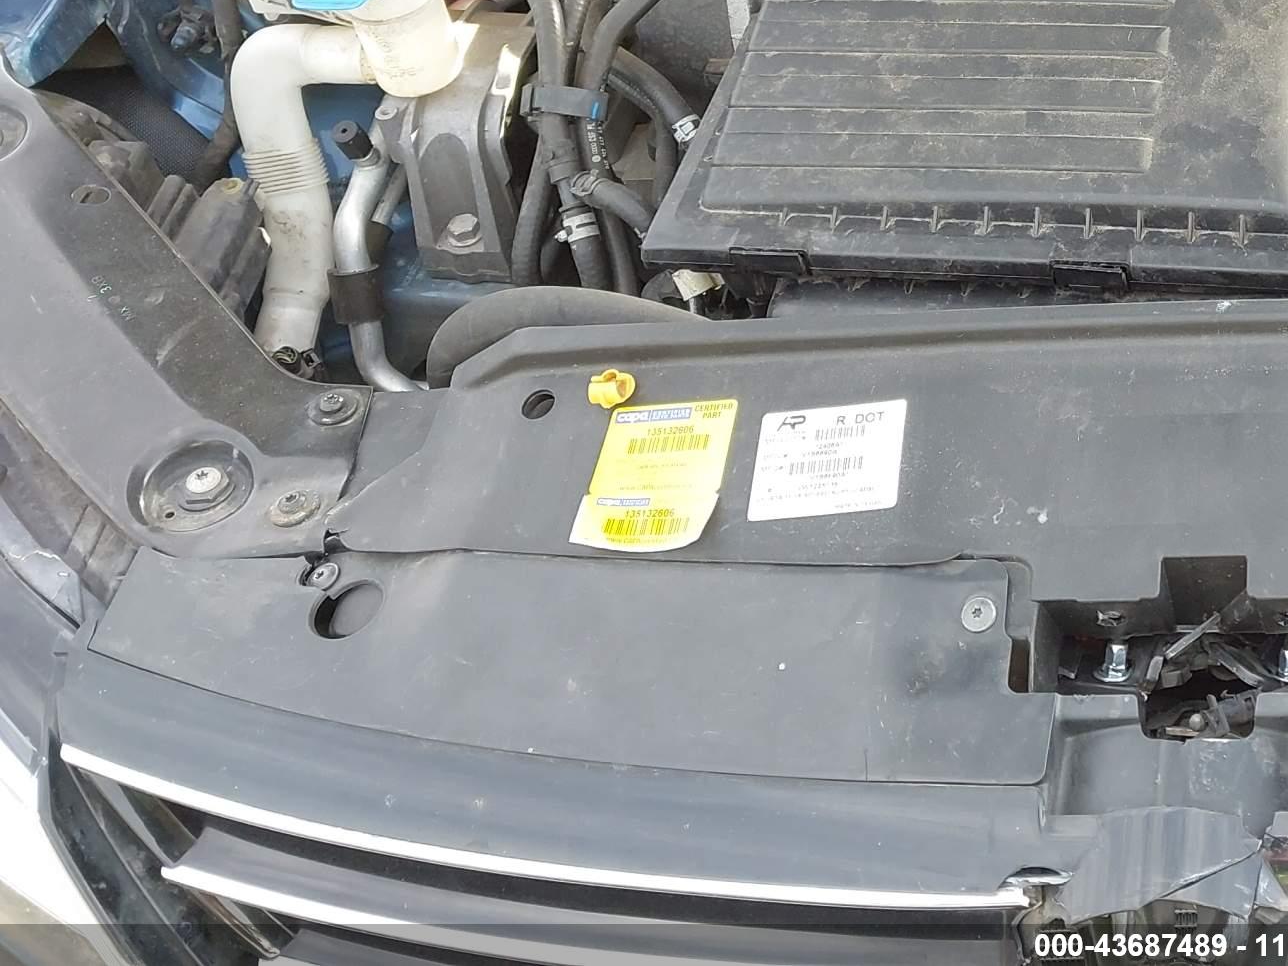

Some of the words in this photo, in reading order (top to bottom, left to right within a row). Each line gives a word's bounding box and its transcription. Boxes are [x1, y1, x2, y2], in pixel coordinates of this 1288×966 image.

[616, 411, 649, 424] capa
[837, 416, 846, 425] R
[855, 411, 885, 424] DOT
